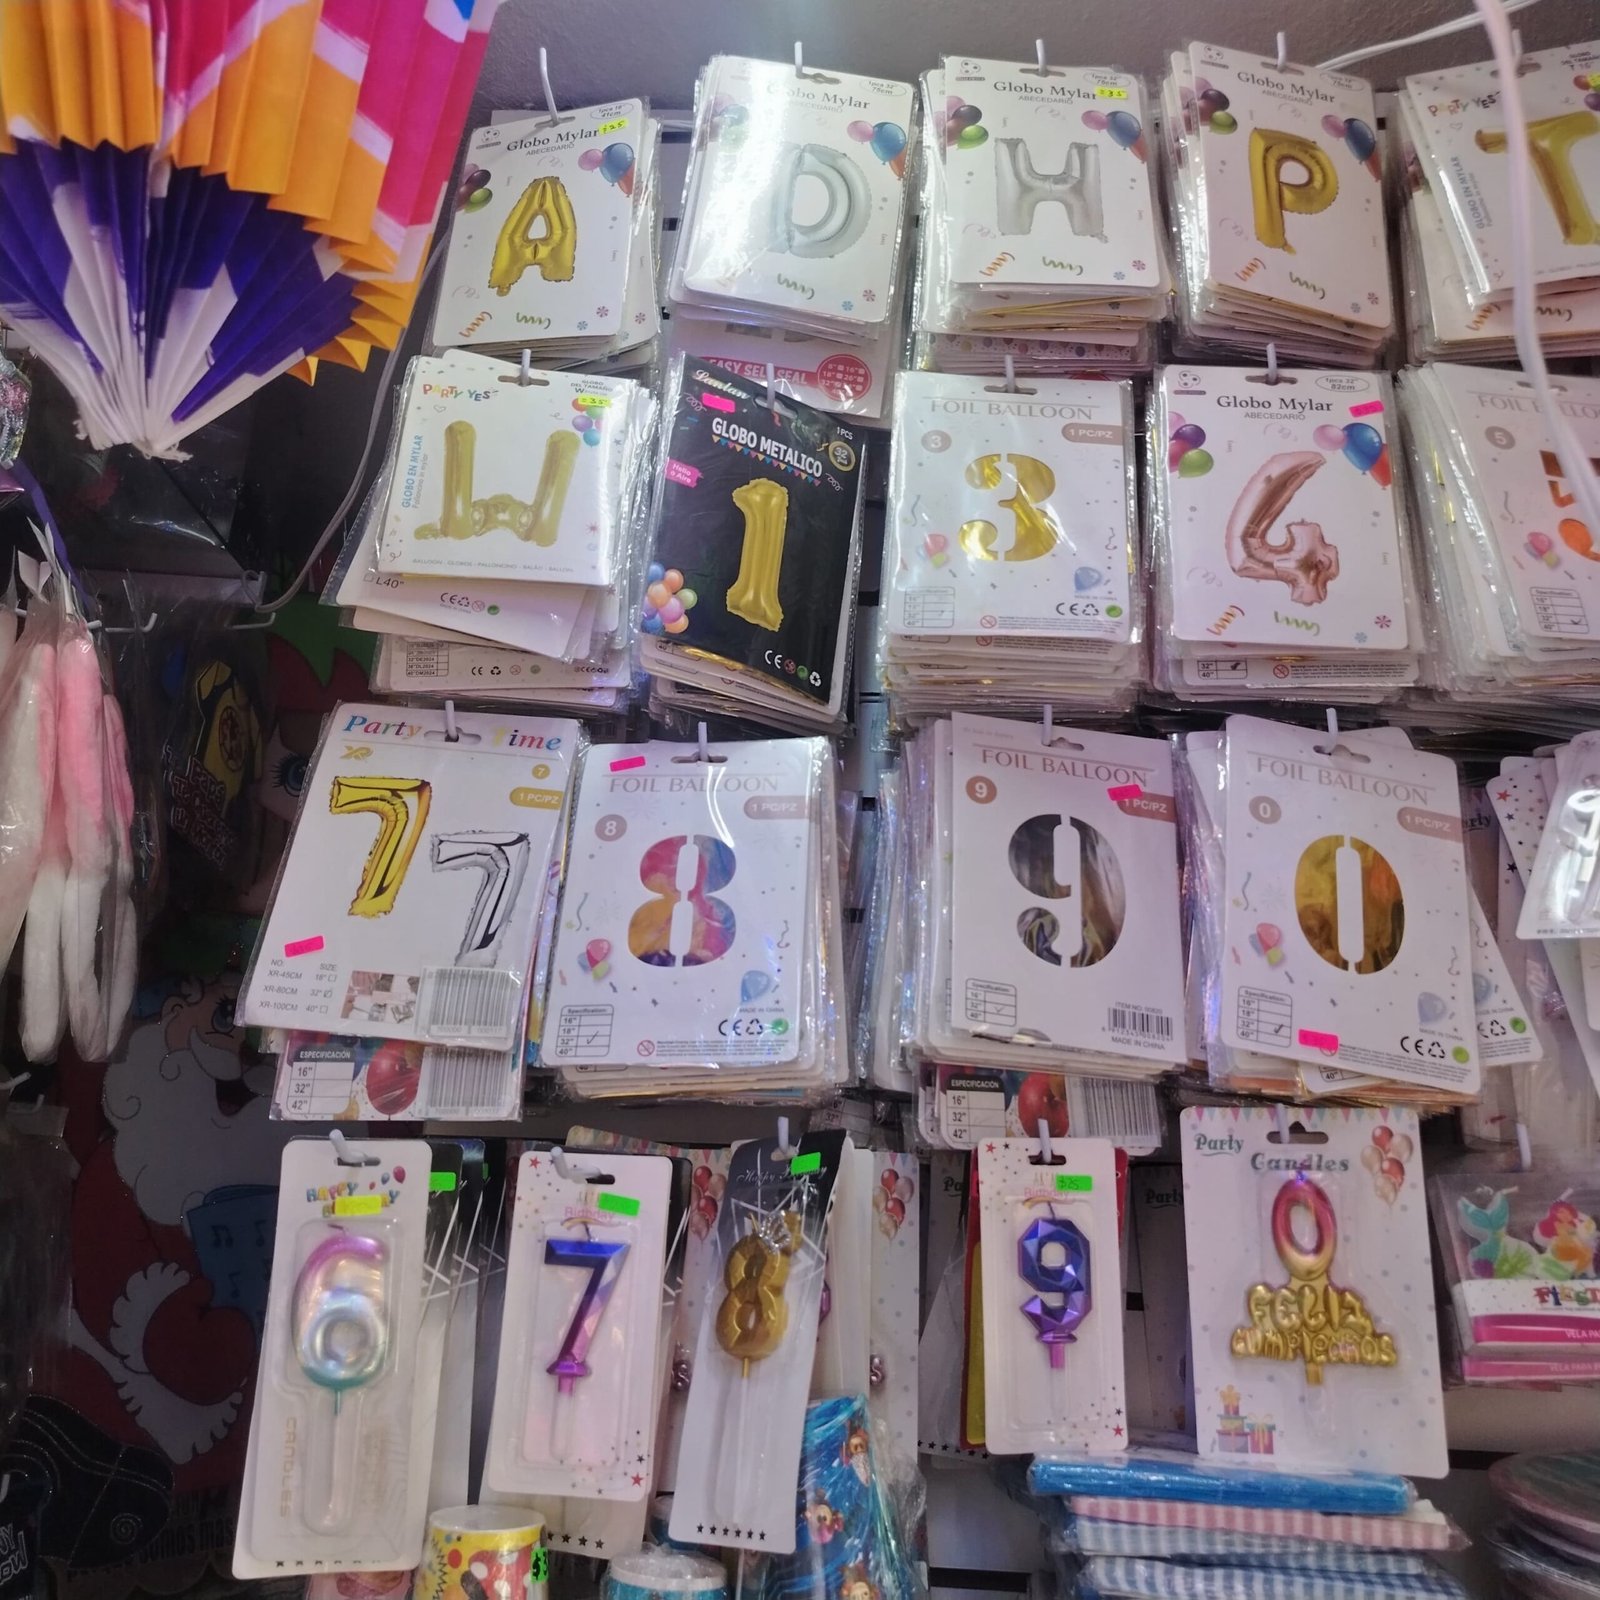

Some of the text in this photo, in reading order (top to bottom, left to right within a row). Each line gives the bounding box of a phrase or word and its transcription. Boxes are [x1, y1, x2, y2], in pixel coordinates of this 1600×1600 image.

[994, 81, 1097, 101] Globo Mylar
[1237, 71, 1336, 104] Globo Mylar
[822, 92, 870, 109] Mylar
[506, 128, 600, 152] Globo Mylar
[994, 138, 1108, 244] H
[1248, 127, 1340, 254] P
[488, 176, 577, 296] A
[744, 364, 770, 378] SEL
[777, 370, 808, 385] SEAL
[422, 383, 464, 399] PARTY
[931, 400, 1093, 420] FOIL BALLOON
[1216, 396, 1272, 409] Globo
[1278, 397, 1333, 414] Mylar
[1478, 395, 1528, 412] FOIL
[1244, 412, 1306, 421] ABECEDARIO
[841, 428, 853, 440] PCS
[930, 436, 942, 448] 3
[1078, 429, 1114, 439] PC/PZ
[712, 417, 822, 478] GLOBO METALICO
[402, 434, 424, 508] GLOBO EN MYLAR
[958, 452, 1059, 562] 3
[1225, 452, 1340, 606] 4
[726, 478, 789, 632] 1
[343, 715, 562, 750] Party Time
[538, 768, 545, 776] 7
[981, 748, 1147, 788] FOIL BALLOON
[610, 776, 779, 794] FOIL BALLOON
[974, 782, 988, 798] 9
[1257, 757, 1428, 806] FOIL BALLOON
[1132, 798, 1168, 814] PC/PZ
[1259, 804, 1271, 818] 0
[605, 820, 617, 836] 8
[1415, 816, 1451, 832] PC/PZ
[329, 776, 432, 919] 7
[1008, 814, 1126, 968] 9
[628, 834, 737, 967] 8
[1294, 834, 1406, 975] 0
[1112, 1036, 1132, 1046] MADE
[1143, 1041, 1166, 1050] CHINA
[300, 1050, 350, 1060] ESPECIFICACIÓN
[297, 1066, 313, 1078] 16"
[294, 1083, 310, 1094] 32"
[951, 1078, 1000, 1089] ESPECIFICACIÓN
[292, 1100, 308, 1110] 42"
[952, 1094, 966, 1104] 16"
[952, 1112, 966, 1122] 32"
[952, 1129, 967, 1138] 42"
[1194, 1133, 1244, 1154] Party
[1250, 1152, 1350, 1172] Candles
[307, 1182, 358, 1202] HAPPY
